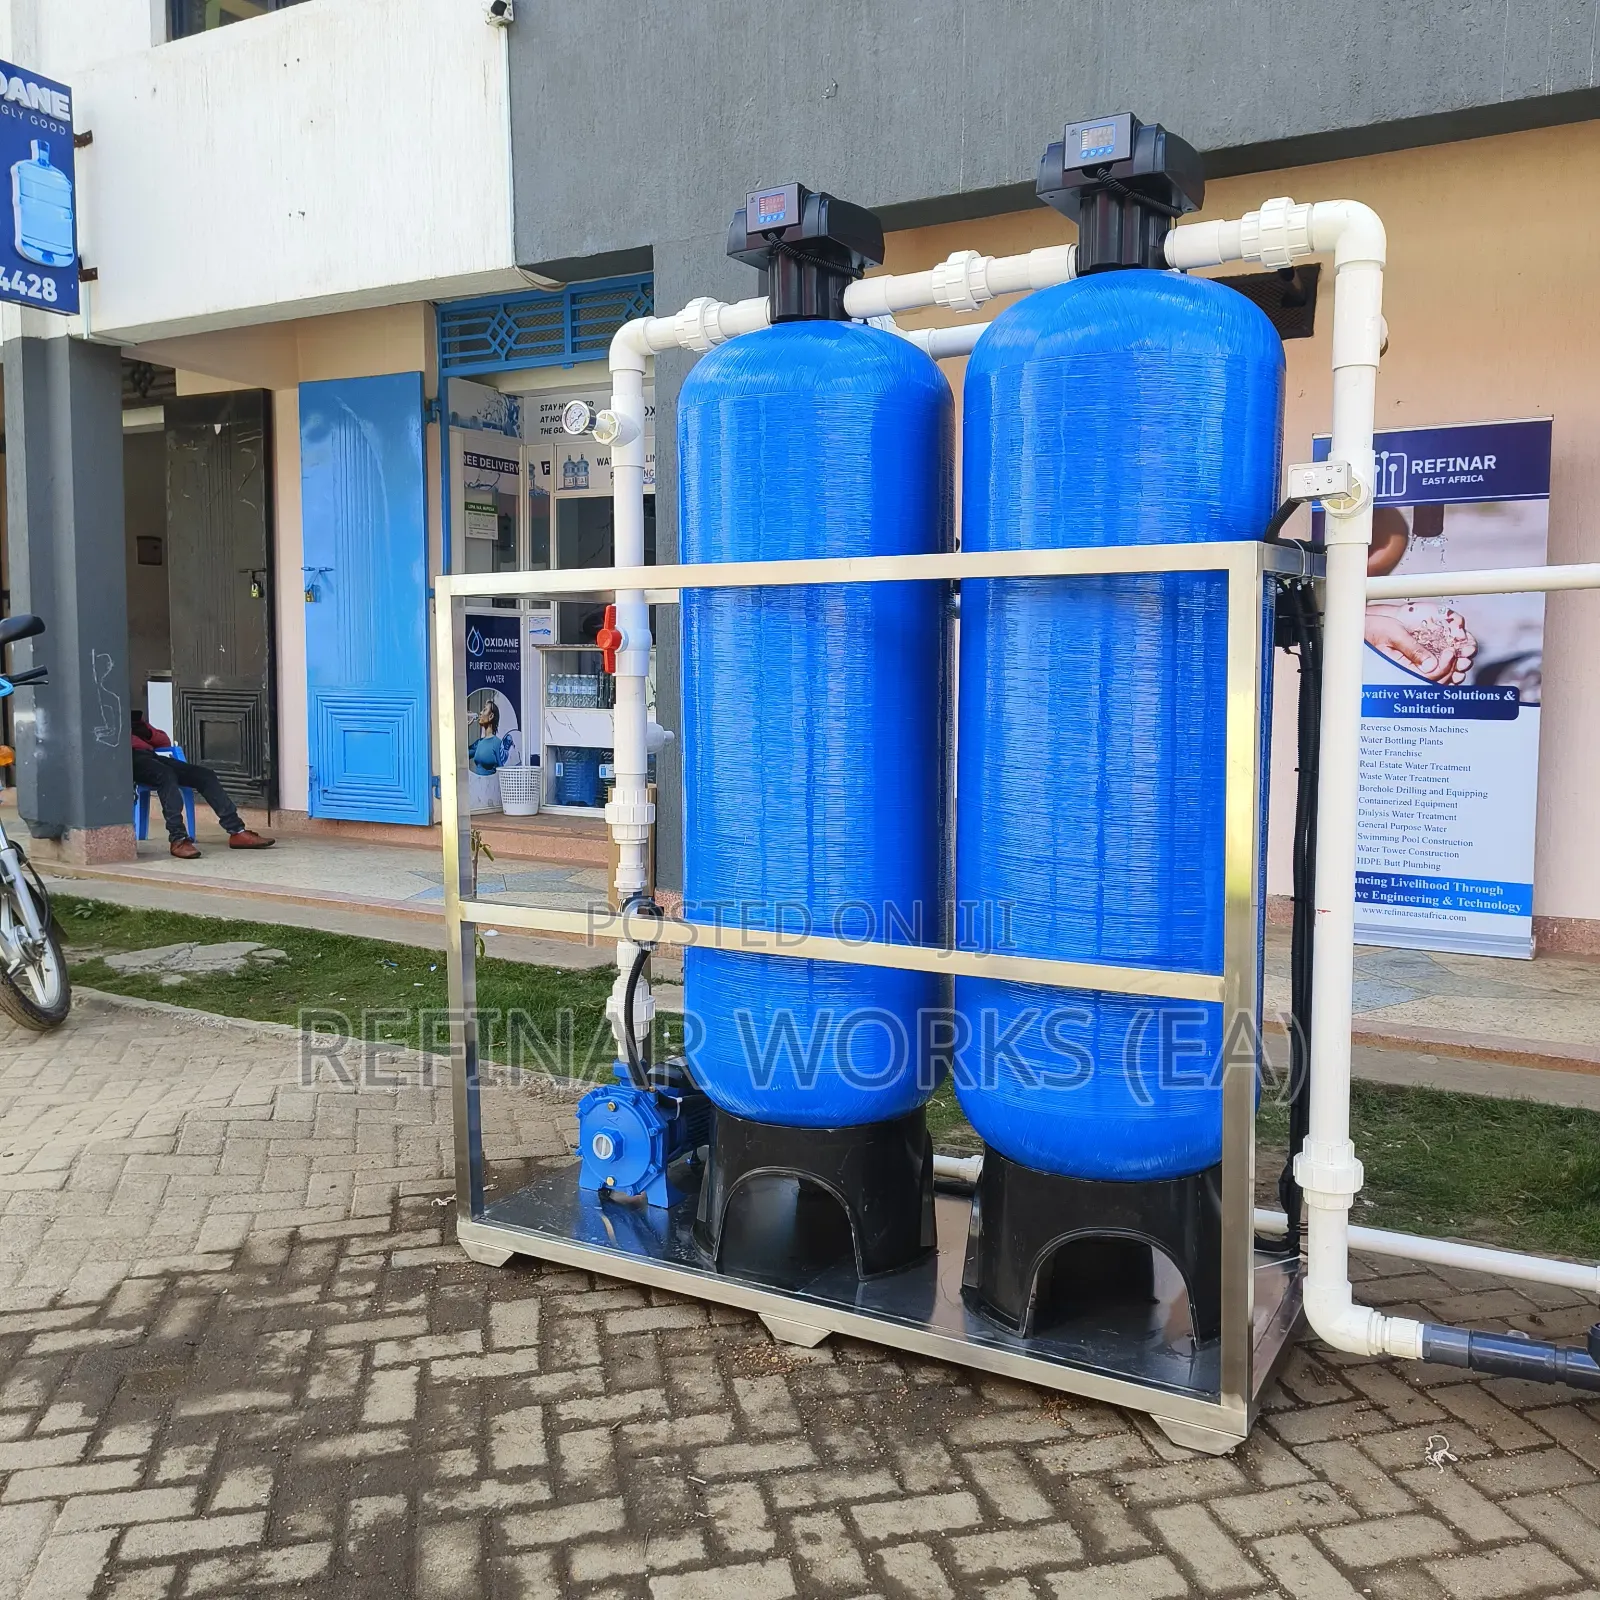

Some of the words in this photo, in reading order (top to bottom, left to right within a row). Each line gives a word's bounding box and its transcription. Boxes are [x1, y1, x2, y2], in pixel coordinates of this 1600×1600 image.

[30, 115, 66, 136] GOOD
[540, 403, 558, 412] STAY
[540, 427, 552, 435] THE
[480, 457, 519, 475] DELIVERY
[1411, 455, 1497, 474] REFINAR
[1422, 477, 1446, 485] EAST
[1448, 474, 1484, 484] AFRICA
[484, 637, 519, 648] OXIDANE
[470, 662, 492, 670] PURIFIED
[494, 662, 520, 670] DRINKING
[486, 675, 505, 683] WATER
[1403, 689, 1440, 700] Water
[1443, 689, 1500, 700] Solutions
[1504, 690, 1515, 700] &
[1393, 703, 1454, 714] Sanitation
[1360, 724, 1391, 732] Reverse
[1429, 725, 1469, 733] Machines
[1360, 735, 1382, 744] Water
[1385, 737, 1417, 746] Bottling
[1419, 737, 1443, 745] Plants
[1360, 748, 1382, 756] Water
[1384, 749, 1422, 757] Franchise
[1360, 760, 1377, 768] Real
[1379, 761, 1403, 769] Estate
[1405, 762, 1428, 770] Water
[1430, 763, 1471, 772] Treatment
[1360, 772, 1382, 780] Waste
[1384, 773, 1407, 781] Water
[1409, 774, 1449, 783] Treatment
[1359, 784, 1394, 793] Borehole
[1396, 786, 1427, 796] Drilling
[1446, 788, 1488, 799] Equipping
[1358, 796, 1412, 806] Containerized
[1414, 799, 1458, 809] Equipment
[1358, 808, 1389, 818] Dialysis
[1392, 810, 1415, 819] Water
[1417, 812, 1457, 821] Treatment
[1358, 821, 1387, 829] General
[1390, 822, 1421, 832] Purpose
[1424, 824, 1447, 832] Water
[1357, 832, 1400, 843] Swimming
[1401, 835, 1420, 843] Pool
[1422, 836, 1474, 847] Construction
[1357, 844, 1380, 853] Water
[1382, 846, 1406, 854] Tower
[1408, 848, 1460, 858] Construction
[1357, 856, 1381, 866] HDPE
[1384, 858, 1401, 867] Butt
[1403, 860, 1441, 871] Plumbing
[1391, 877, 1450, 891] Livelihood
[1453, 881, 1504, 896] Through
[1372, 890, 1439, 907] Engineering
[1442, 896, 1453, 906] &
[1457, 897, 1522, 913] Technology
[1362, 907, 1467, 921] www.refinareastafrica.com
